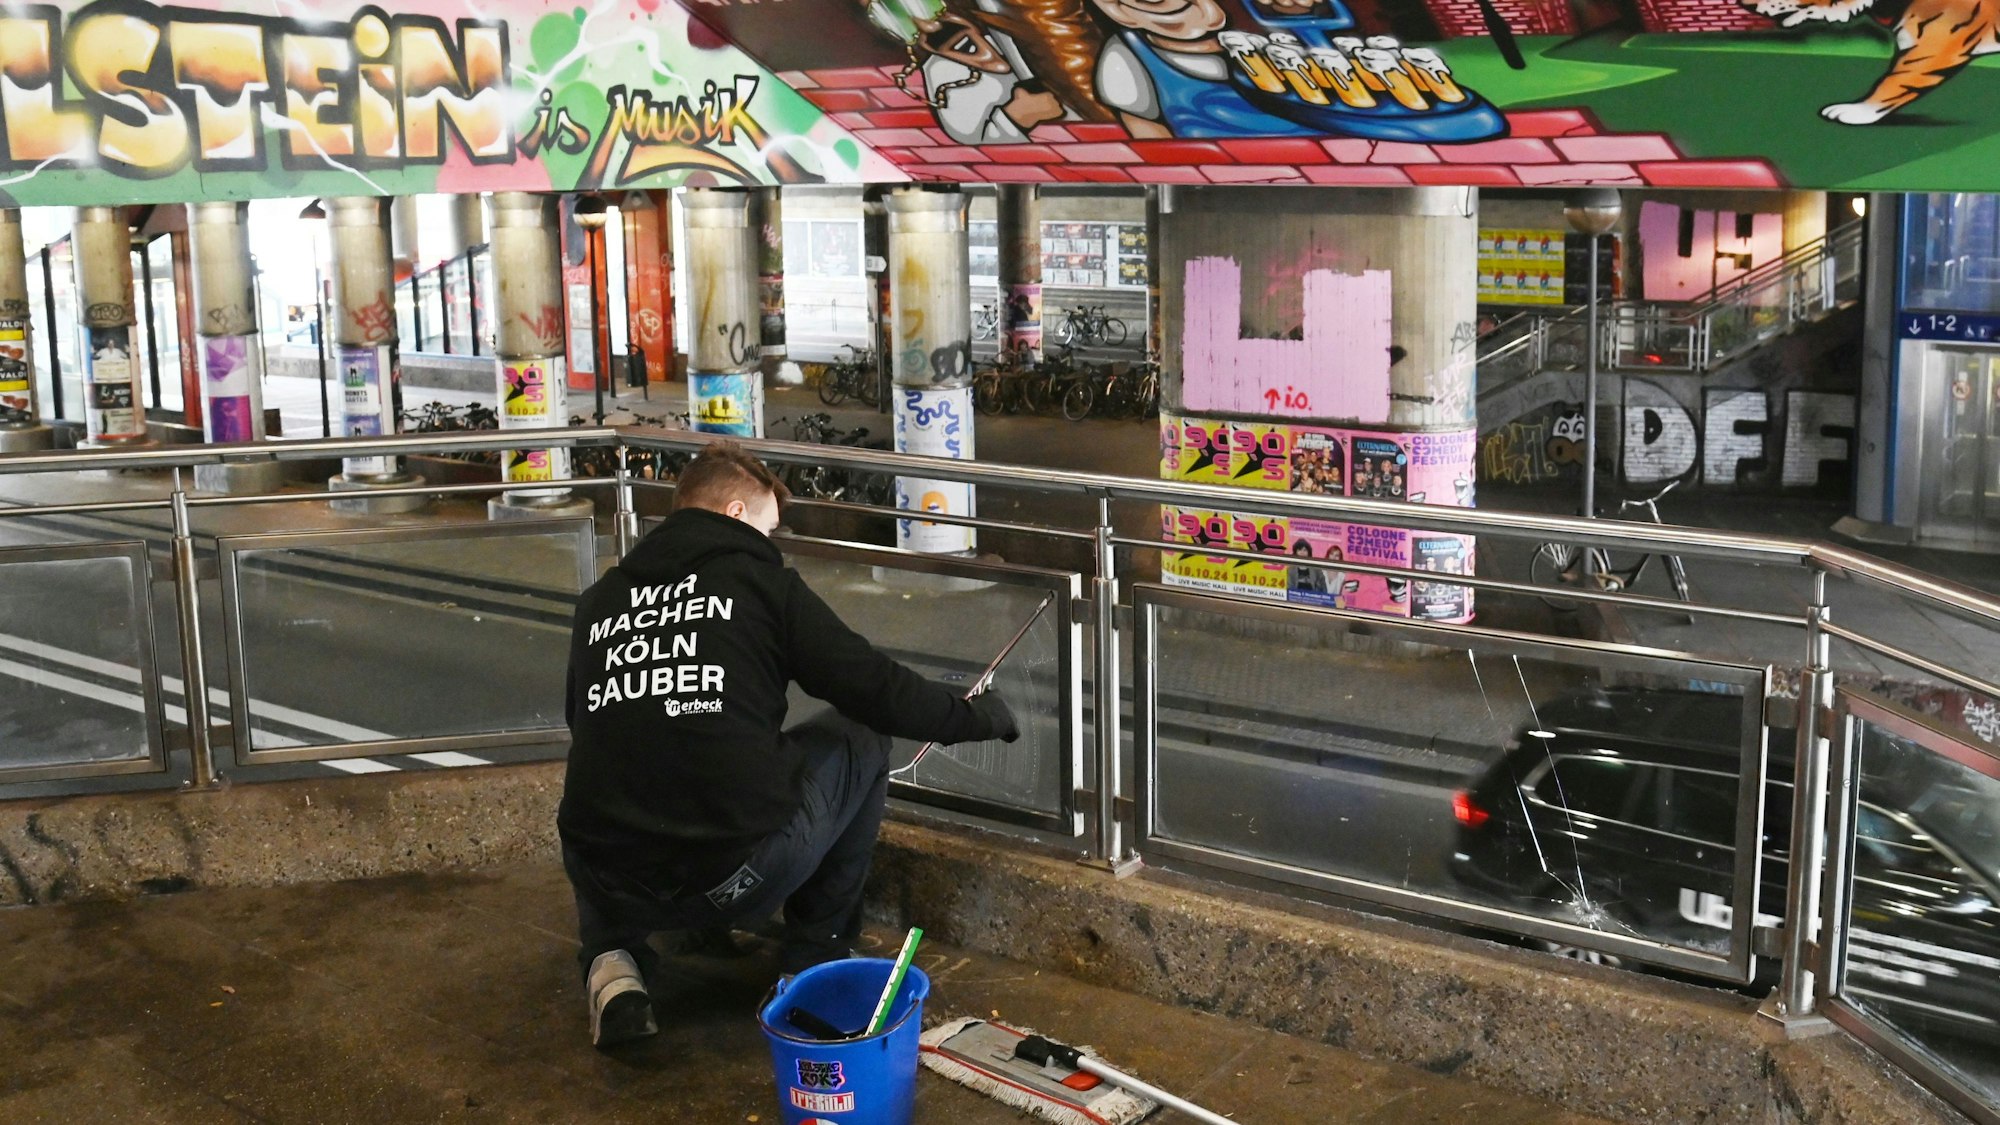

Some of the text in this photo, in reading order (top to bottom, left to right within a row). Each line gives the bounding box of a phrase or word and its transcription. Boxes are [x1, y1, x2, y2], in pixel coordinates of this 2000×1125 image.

[1928, 314, 1957, 332] 1-2
[1412, 434, 1468, 446] COLOGNE
[1412, 454, 1468, 466] FESTIVAL
[1347, 525, 1406, 541] COLOGNE
[1347, 545, 1407, 561] FESTIVAL
[630, 573, 698, 608] WIR
[588, 595, 733, 646] MACHEN
[605, 632, 698, 671] KÖLN
[587, 664, 725, 713] SAUBER
